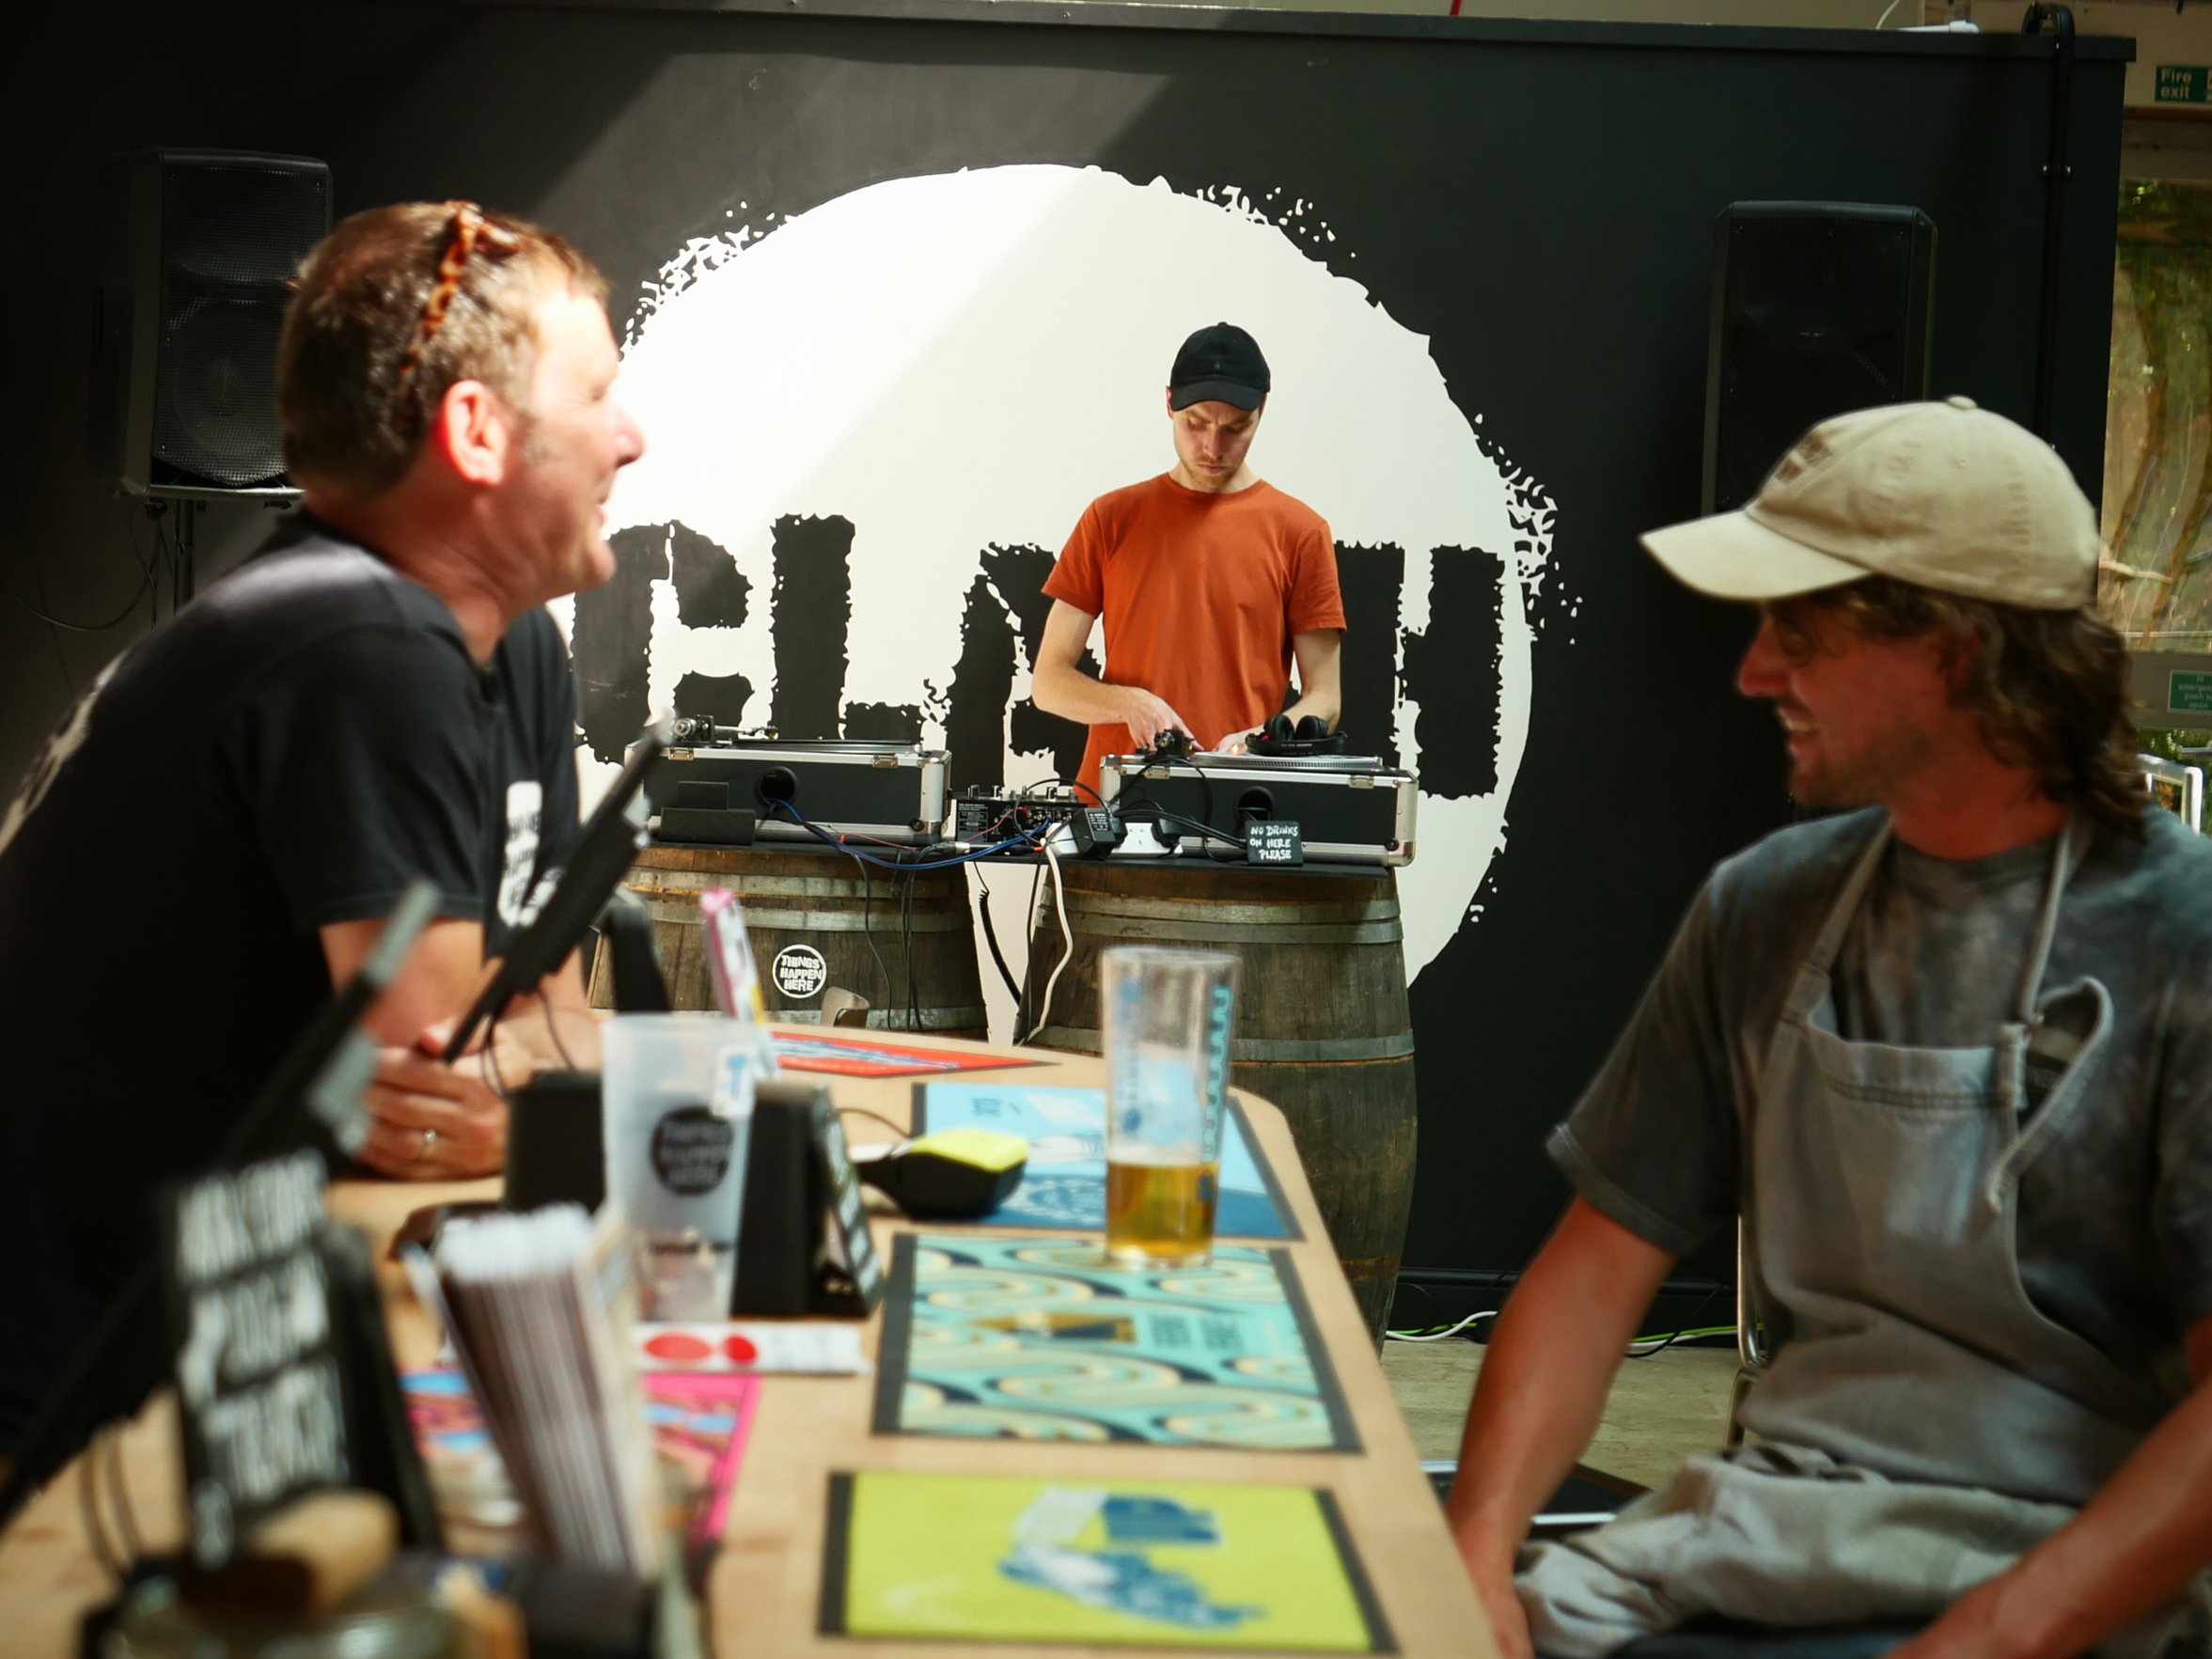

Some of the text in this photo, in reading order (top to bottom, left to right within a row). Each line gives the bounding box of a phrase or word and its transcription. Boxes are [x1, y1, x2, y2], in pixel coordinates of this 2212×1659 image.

[2161, 68, 2192, 85] Fire
[2160, 84, 2190, 101] exit
[570, 512, 1506, 800] CLAH
[2178, 683, 2212, 695] emergen
[1250, 825, 1298, 837] NO DRINKS
[1249, 838, 1292, 849] ON HERE
[1259, 849, 1292, 861] PLEASE
[781, 955, 820, 969] THINGS
[779, 967, 823, 980] HAPPEN
[784, 979, 814, 992] HERE
